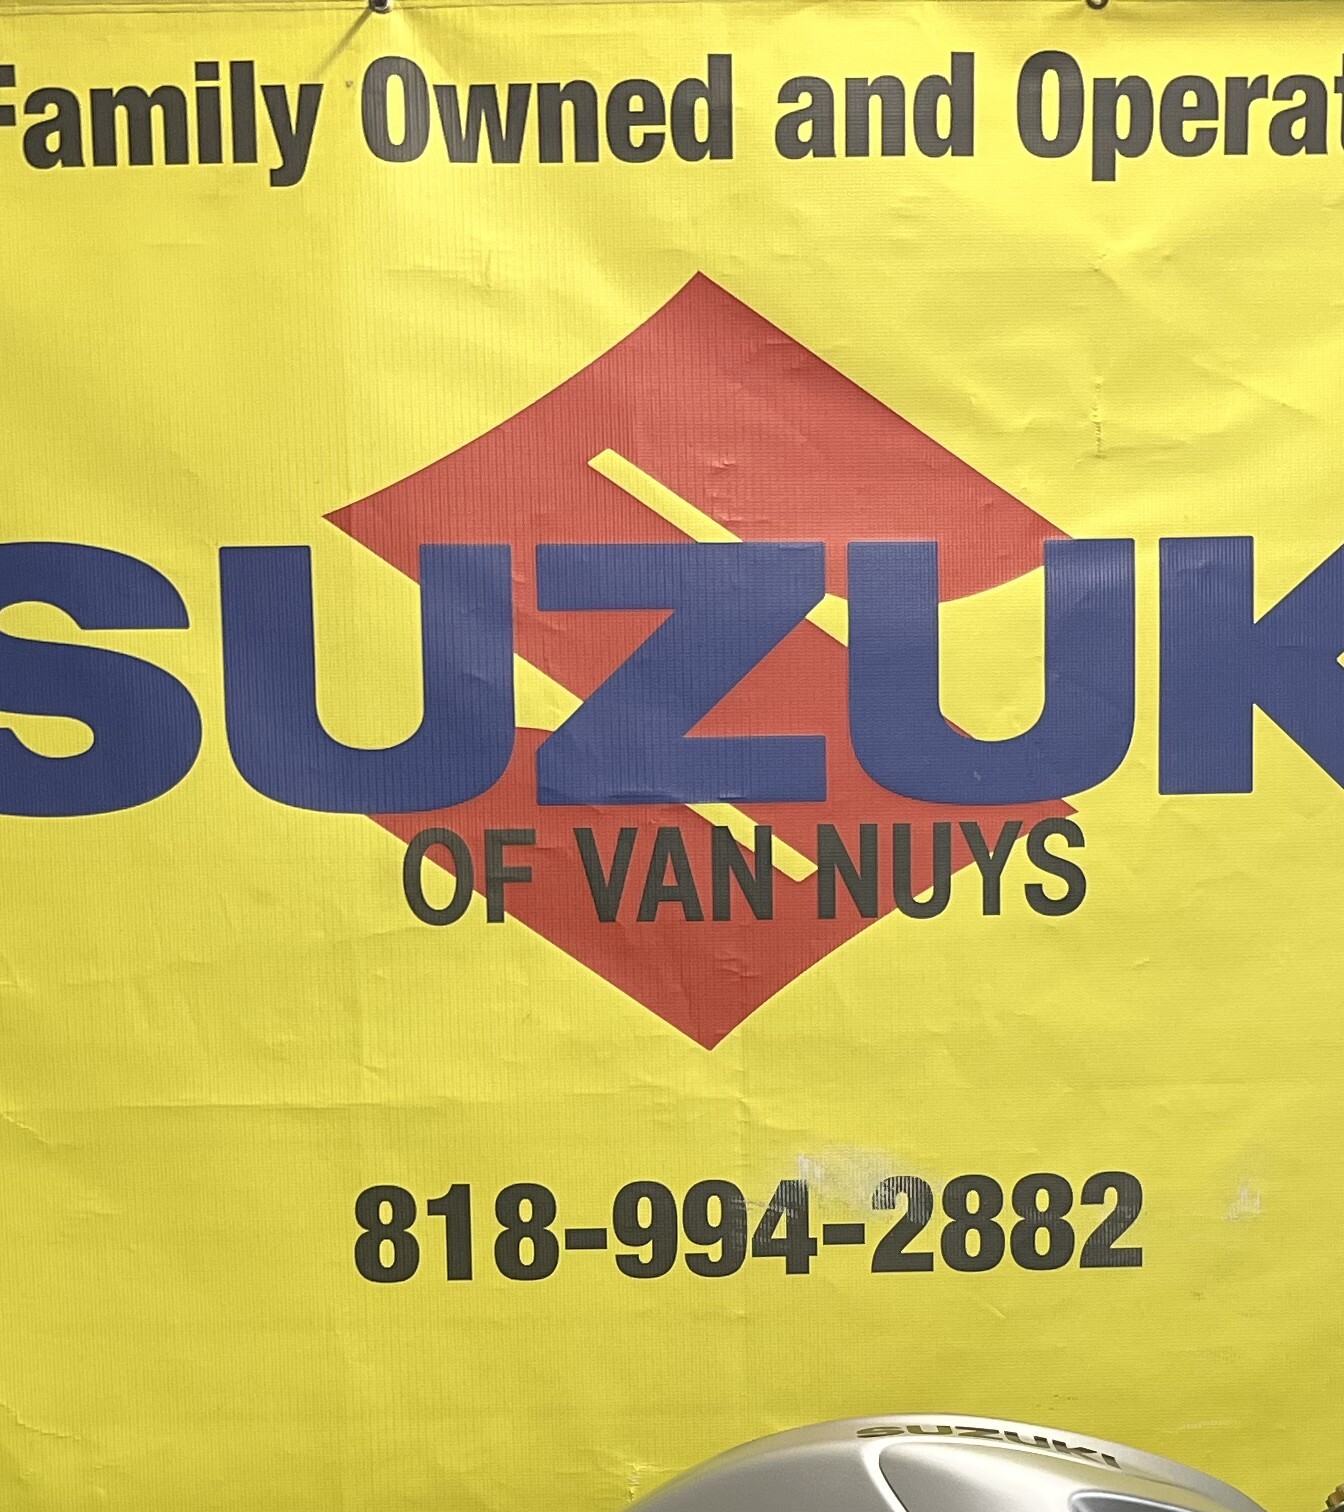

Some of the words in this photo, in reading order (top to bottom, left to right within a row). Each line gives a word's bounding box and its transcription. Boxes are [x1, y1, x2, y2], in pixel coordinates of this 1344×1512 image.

[360, 53, 733, 164] Owned
[774, 51, 975, 160] and
[402, 826, 537, 926] OF
[572, 824, 774, 923] VAN
[816, 817, 1088, 920] NUYS
[353, 1171, 1144, 1284] 818-994-2882
[856, 1425, 1122, 1469] SUZUKI
